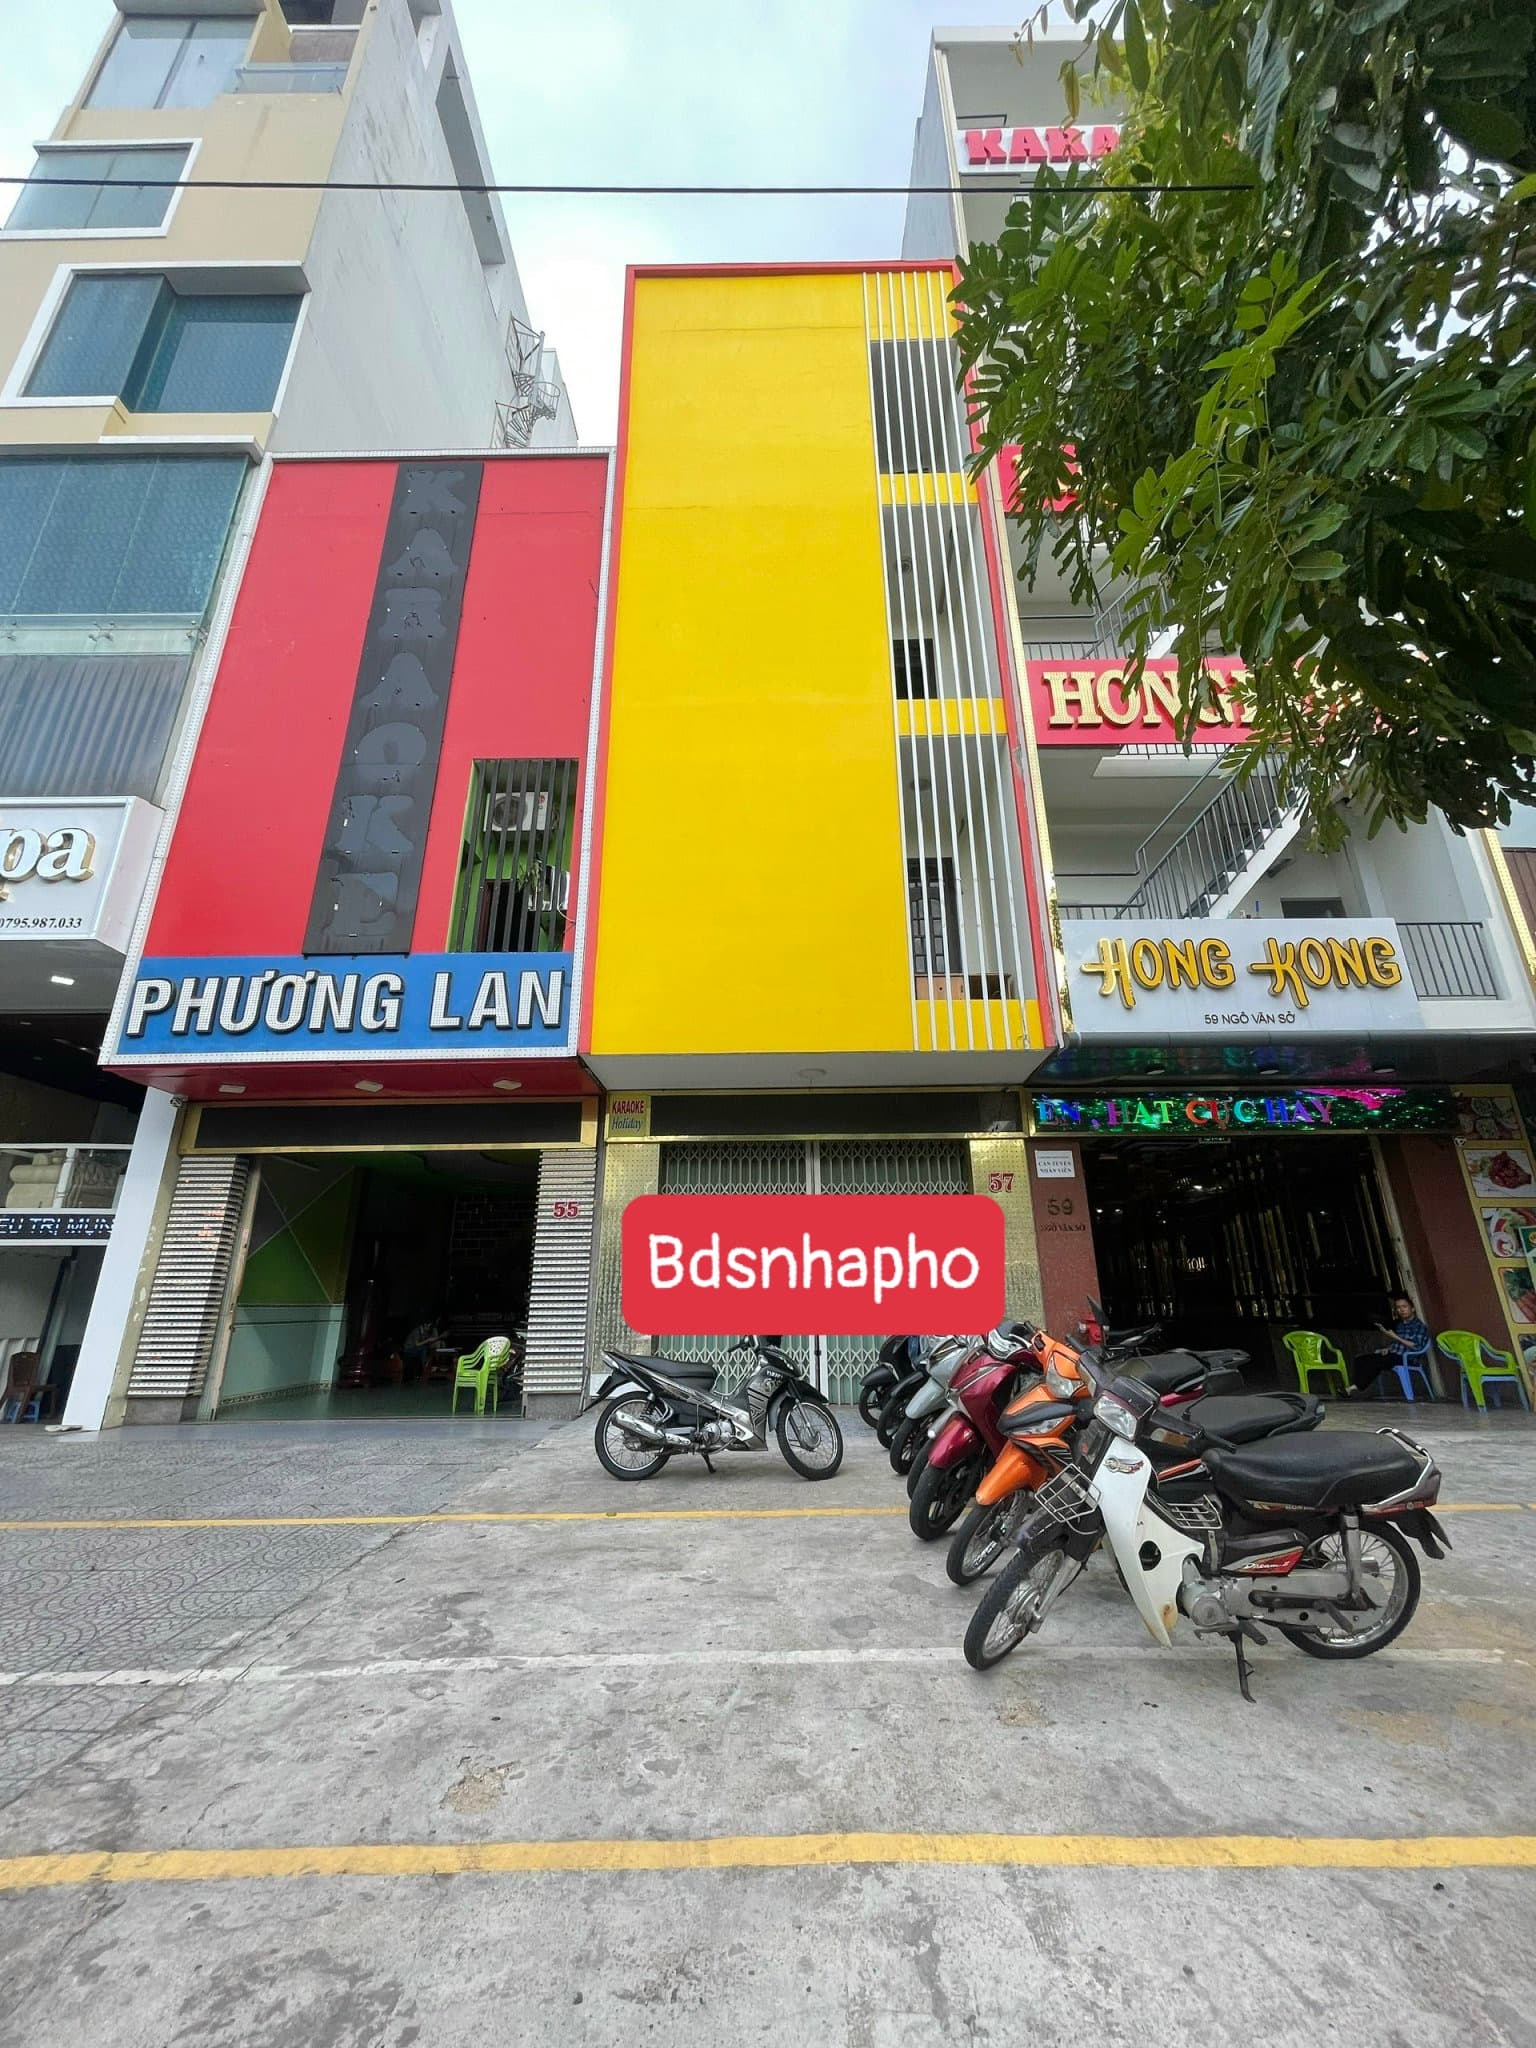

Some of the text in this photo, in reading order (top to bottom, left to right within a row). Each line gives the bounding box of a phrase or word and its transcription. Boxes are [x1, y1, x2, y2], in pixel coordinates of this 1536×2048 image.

[1079, 936, 1402, 1009] HONG KONG
[125, 968, 565, 1039] PHƯƠNG LAN
[1204, 1010, 1296, 1025] 59 NGÔ VĂN SỞ
[611, 1100, 645, 1114] KARAOKE
[1263, 1097, 1335, 1123] HAY
[611, 1115, 642, 1131] Holiday
[988, 1172, 1016, 1193] 57
[553, 1201, 580, 1219] 55
[1047, 1197, 1073, 1216] 59
